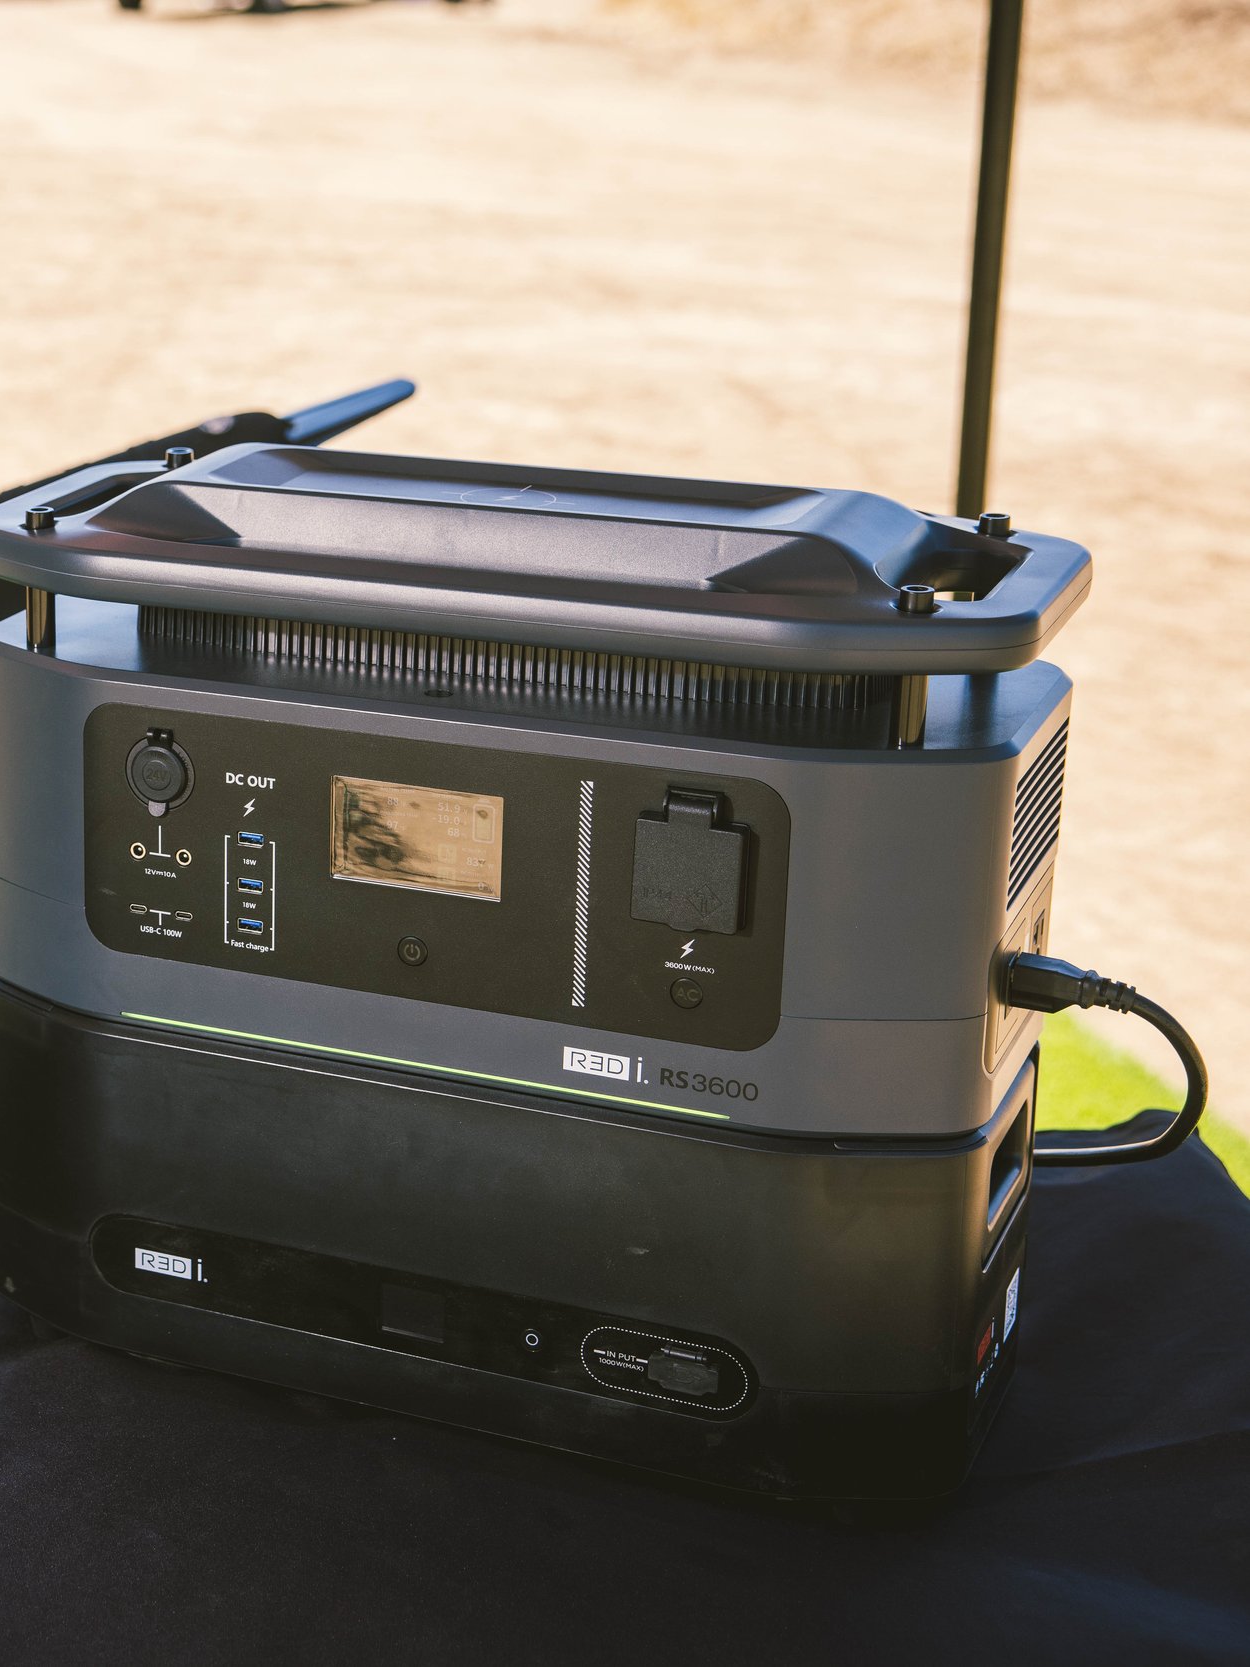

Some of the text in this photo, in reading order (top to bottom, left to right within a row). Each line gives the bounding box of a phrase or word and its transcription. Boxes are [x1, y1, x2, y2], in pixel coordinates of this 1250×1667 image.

[225, 772, 276, 790] DC OUT
[242, 857, 257, 867] 18W
[242, 900, 257, 910] 18W
[140, 924, 183, 938] USB-C 100W
[230, 939, 270, 953] Fast charge
[675, 986, 700, 1002] AC
[606, 1350, 637, 1363] IN PUT
